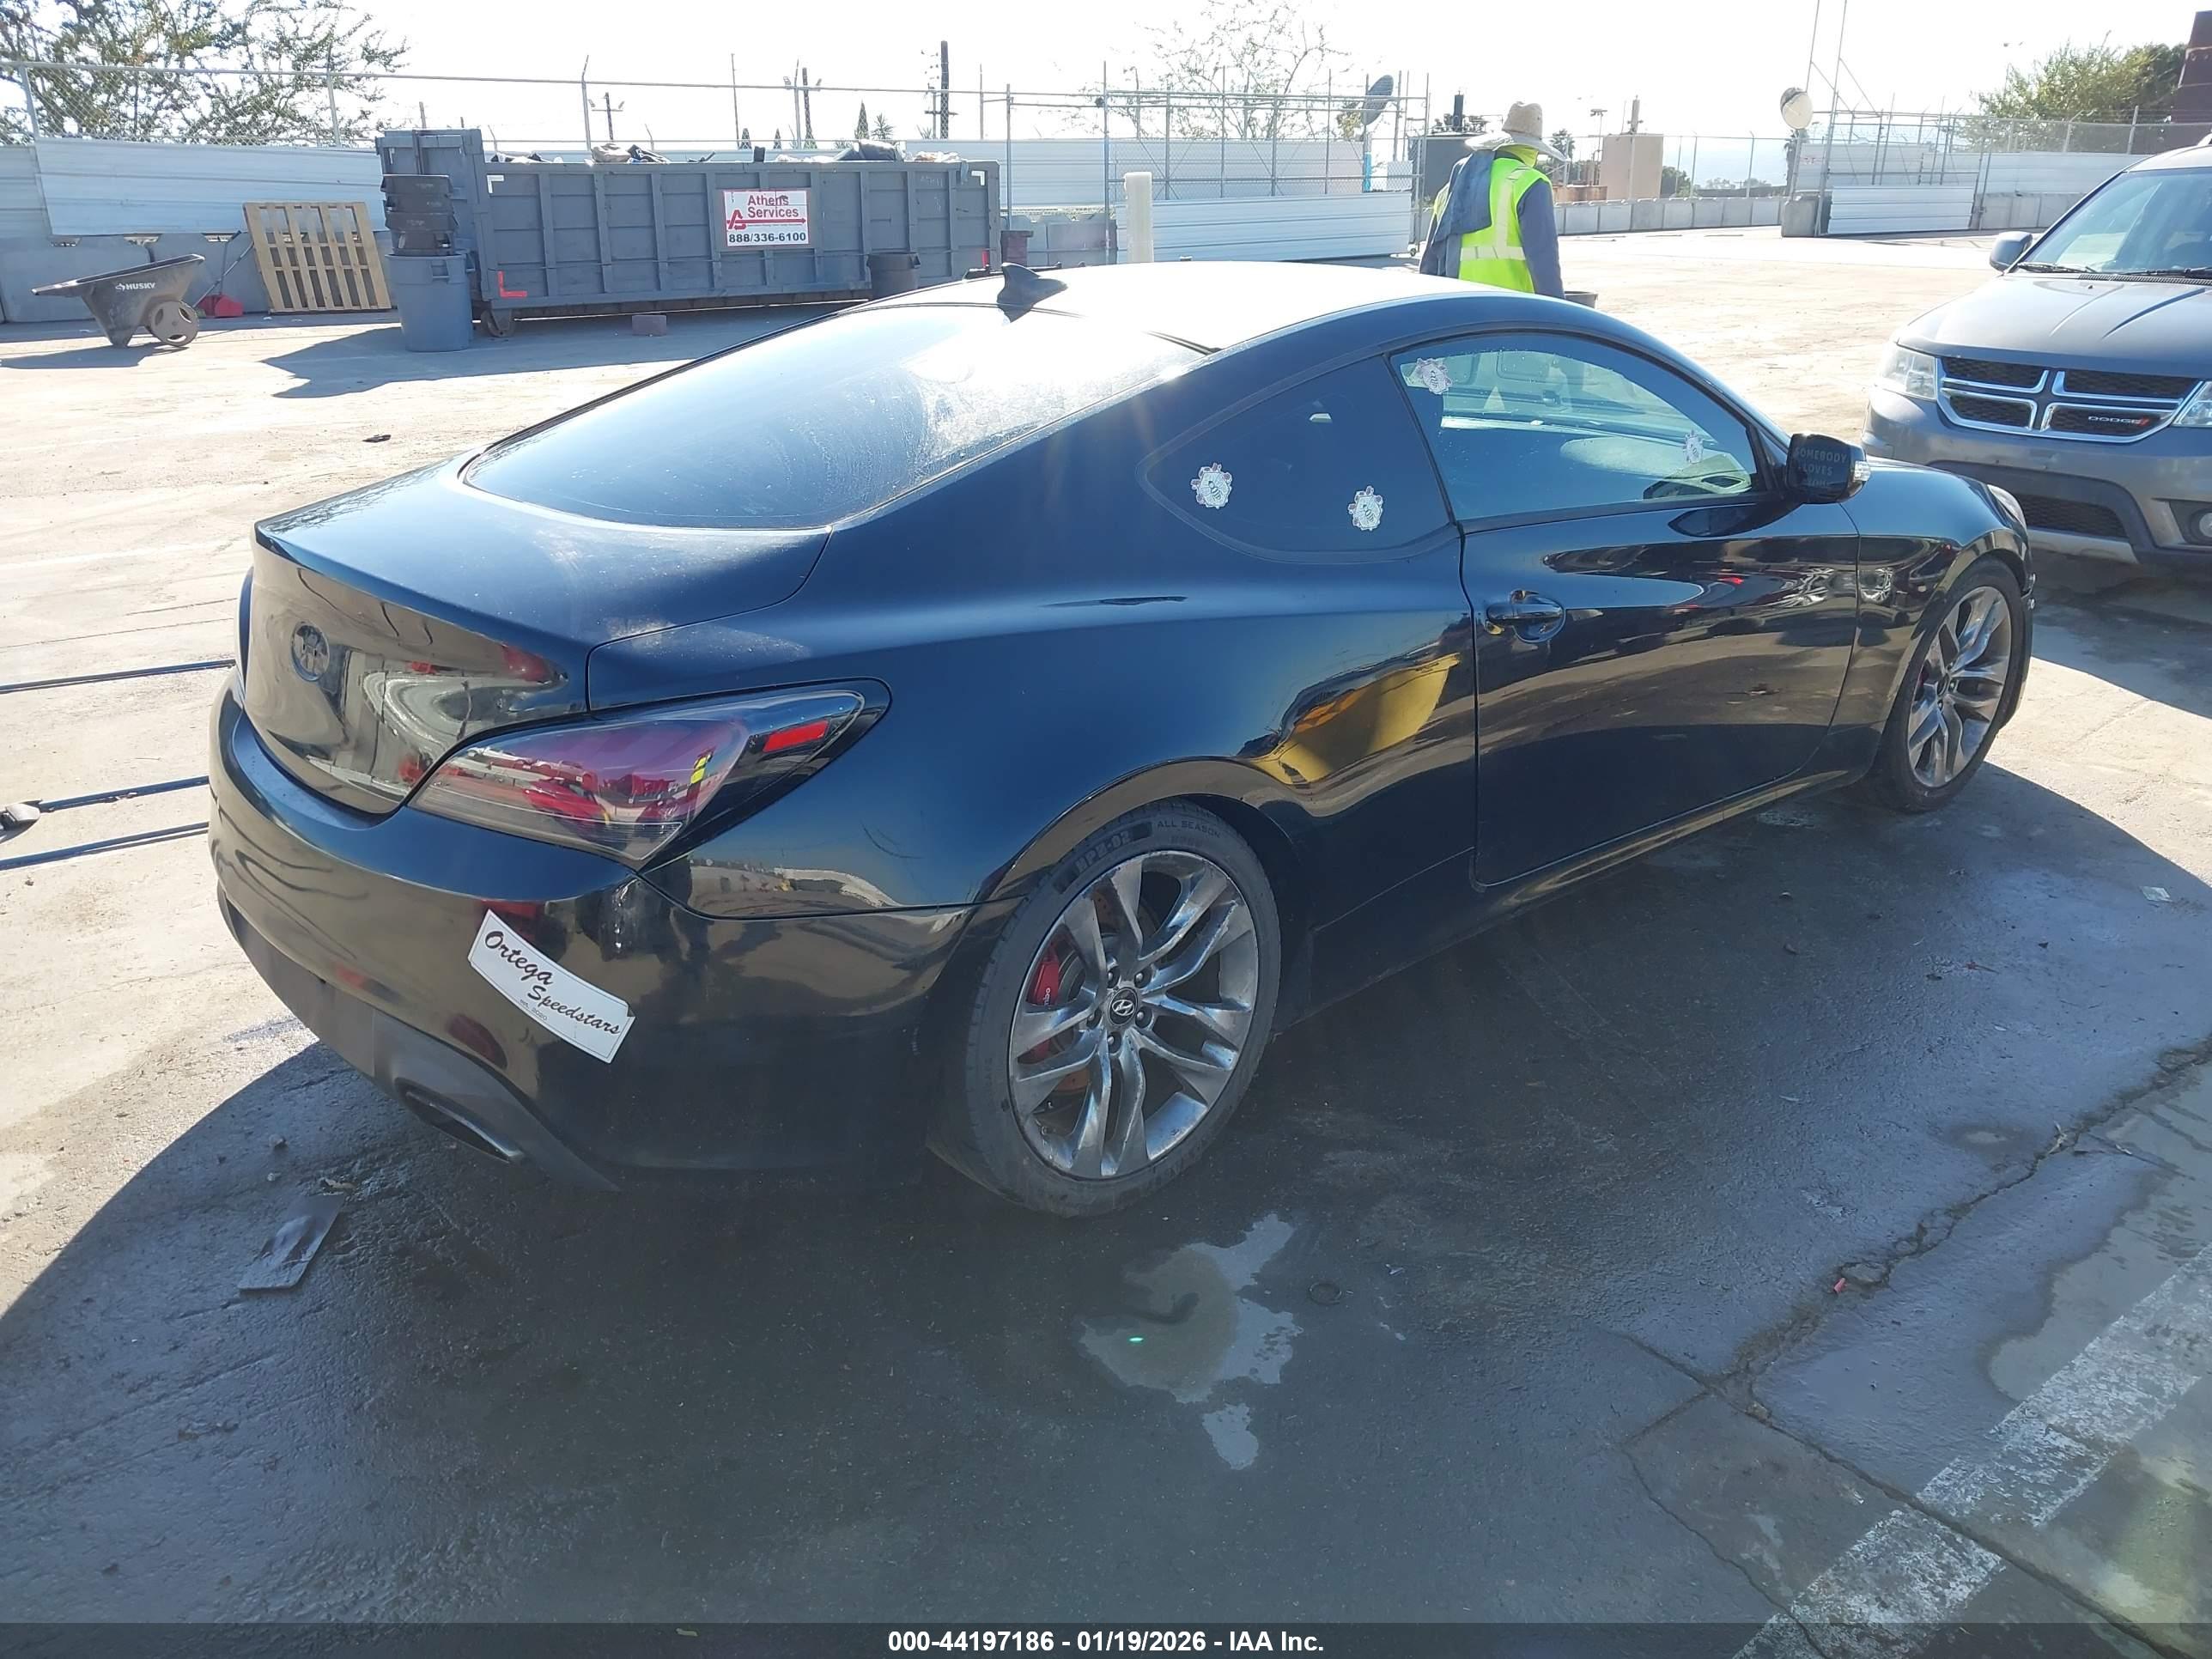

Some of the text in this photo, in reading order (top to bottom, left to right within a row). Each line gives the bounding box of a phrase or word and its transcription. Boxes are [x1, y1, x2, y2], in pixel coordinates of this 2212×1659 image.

[748, 195, 789, 206] Athens
[747, 207, 799, 218] Services
[729, 233, 806, 243] 888/336-6100
[2087, 416, 2141, 424] DODGE
[1792, 447, 1847, 463] SOMEBODY
[1802, 462, 1833, 476] LOVES
[1181, 820, 1221, 838] SEASON
[484, 931, 554, 986] Ortega
[527, 985, 621, 1036] Speedstars
